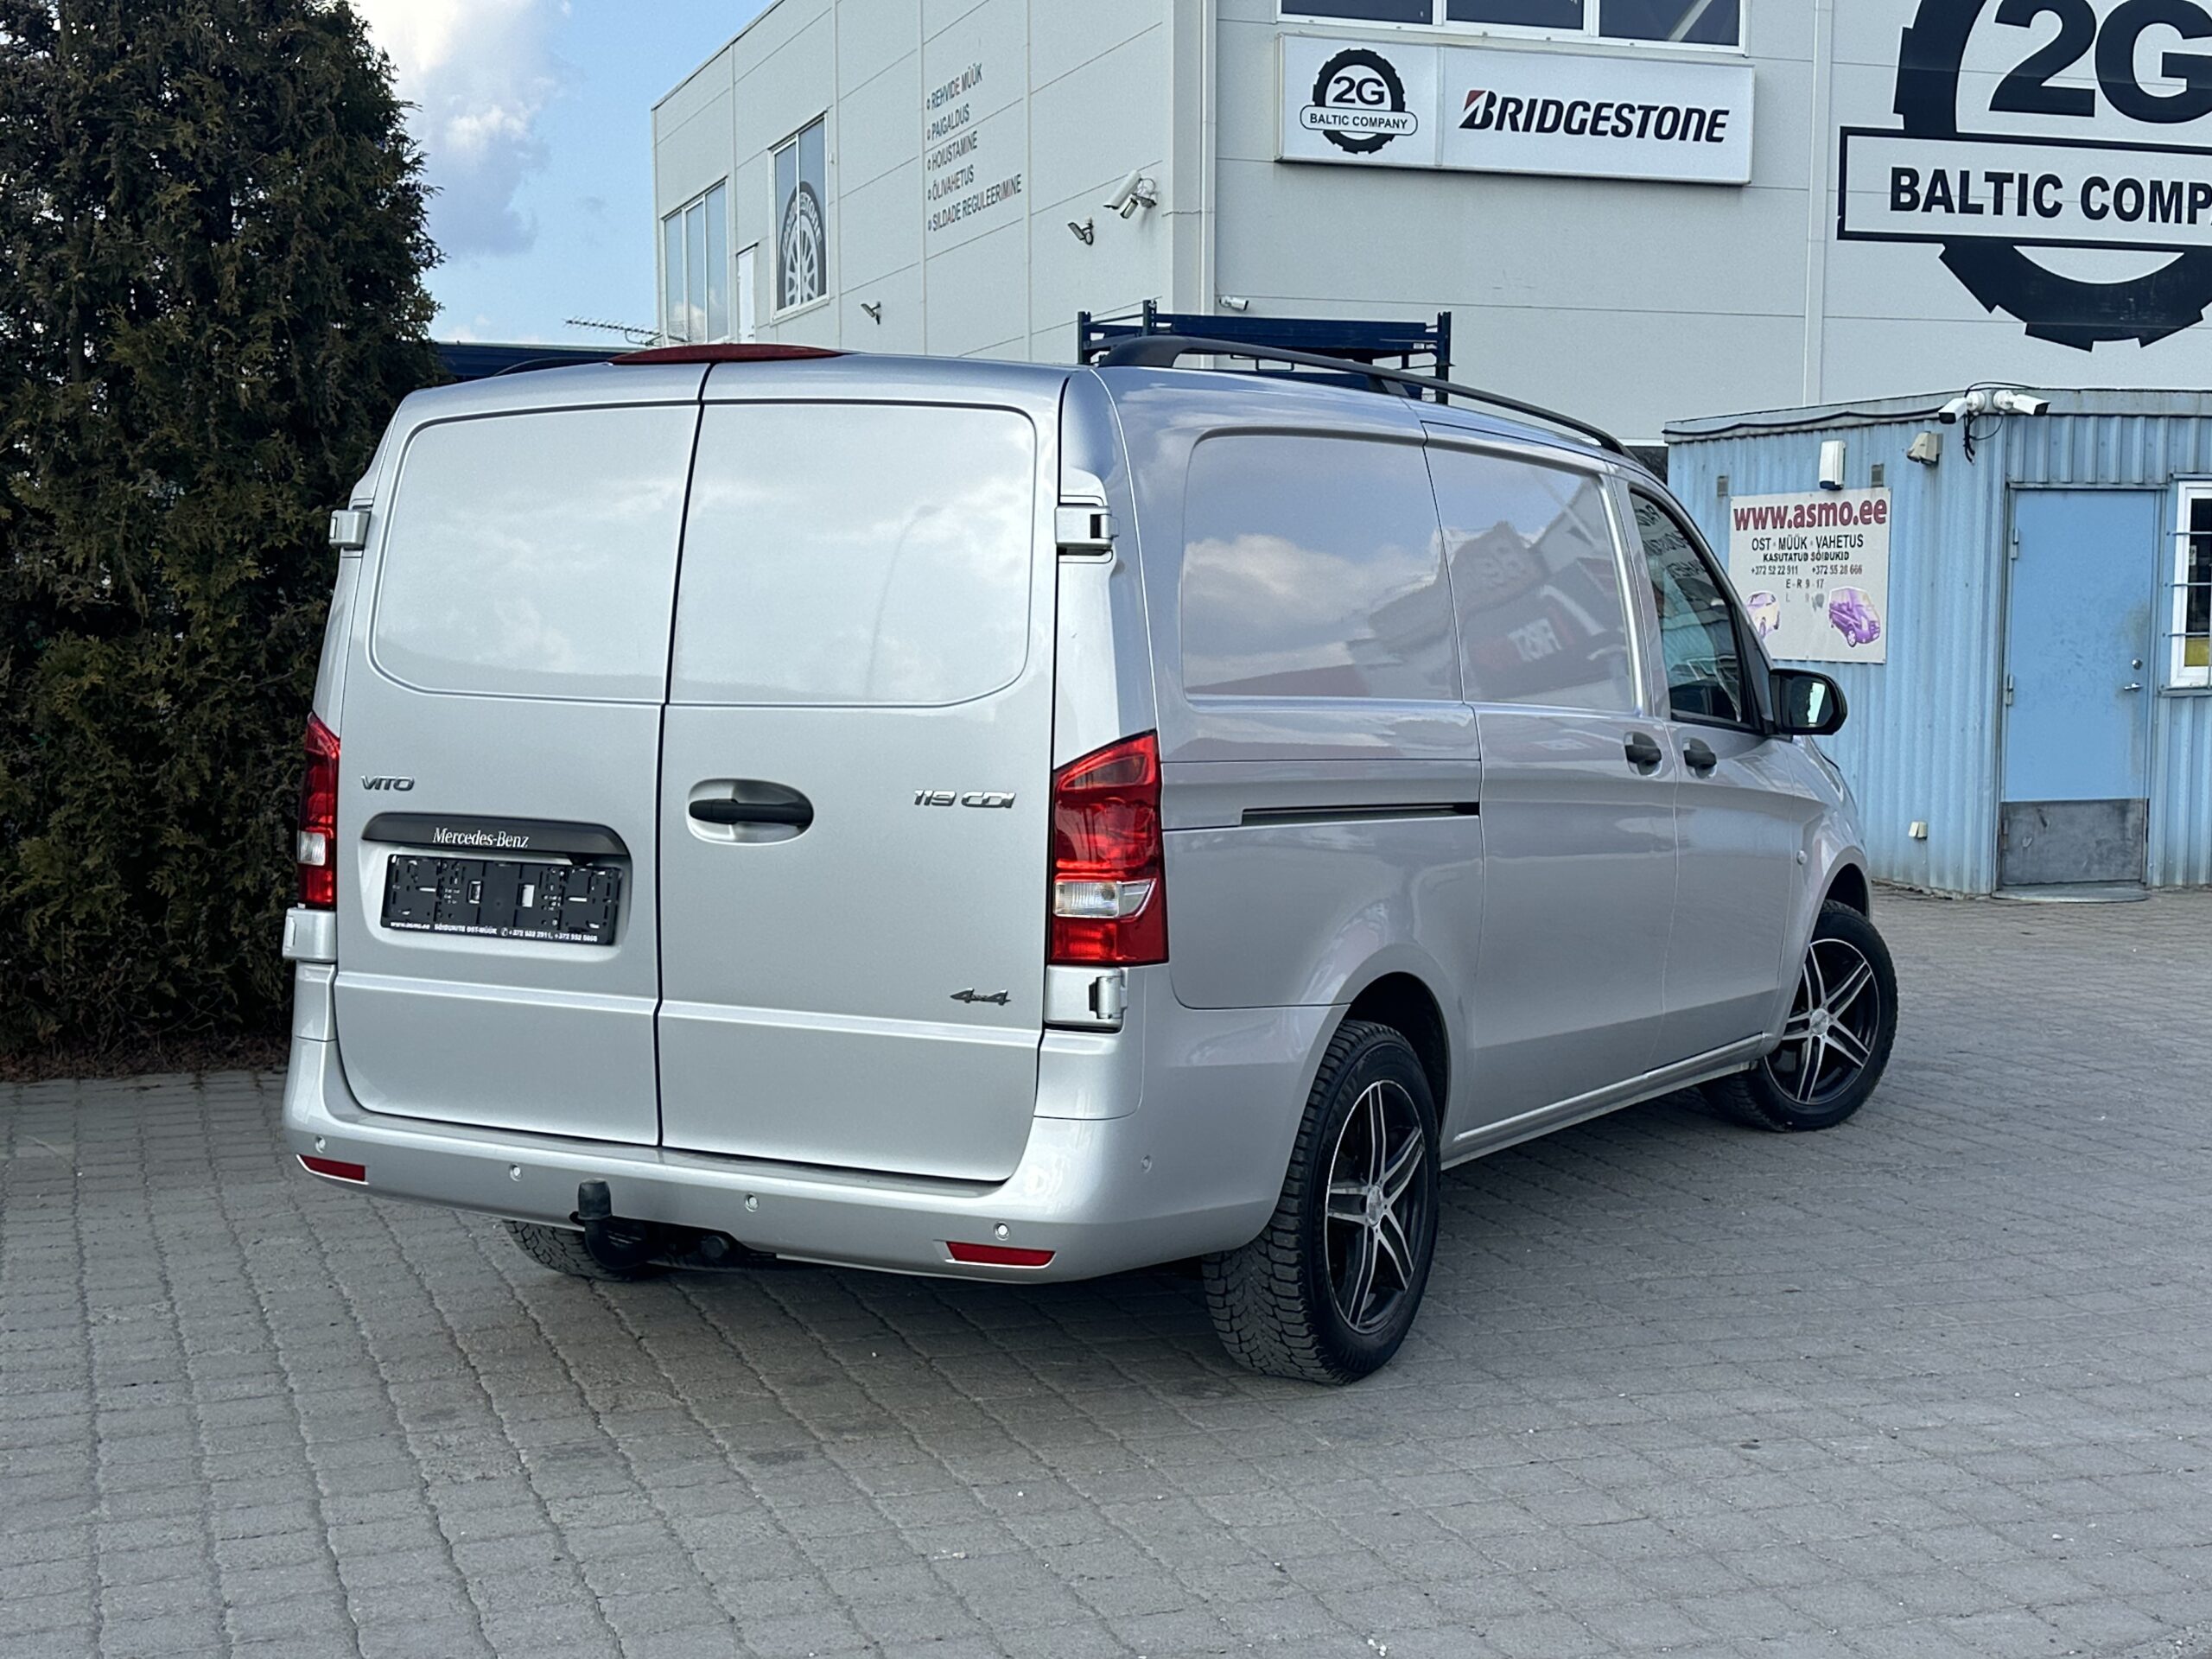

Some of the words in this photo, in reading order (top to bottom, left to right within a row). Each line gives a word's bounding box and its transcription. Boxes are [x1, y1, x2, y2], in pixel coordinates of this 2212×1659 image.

[1988, 0, 2212, 124] 2G
[931, 76, 960, 110] REHVIDE
[961, 62, 982, 92] MÜÜK
[1332, 75, 1384, 105] 2G
[931, 103, 969, 140] PAIGALDUS
[1310, 112, 1350, 128] BALTIC
[1351, 115, 1408, 130] COMPANY
[1459, 90, 1730, 143] BRIDGESTONE
[931, 130, 977, 171] HOIUSTAMINE
[932, 201, 961, 232] SILDADE
[962, 174, 1022, 218] REGULEERIMINE
[1890, 167, 2064, 219] BALTIC
[2080, 176, 2212, 226] COMP
[1733, 499, 1887, 531] www.asmo.ee
[1751, 537, 1771, 550] OST
[1778, 534, 1808, 550] MÜÜK
[1815, 533, 1864, 549] VAHETUS
[1763, 552, 1808, 563] KASUTATUD
[1810, 550, 1849, 562] SÕIDUKID
[1812, 564, 1827, 575] +372
[1829, 564, 1838, 575] 55
[1751, 565, 1766, 575] +372
[1768, 565, 1776, 575] 52
[1777, 565, 1786, 575] 22
[1787, 565, 1798, 575] 911
[360, 775, 415, 791] VITO
[913, 789, 957, 807] 119
[961, 791, 1016, 809] CDI
[432, 827, 529, 849] Mercedes-Benz
[950, 987, 1012, 1007] 4x4
